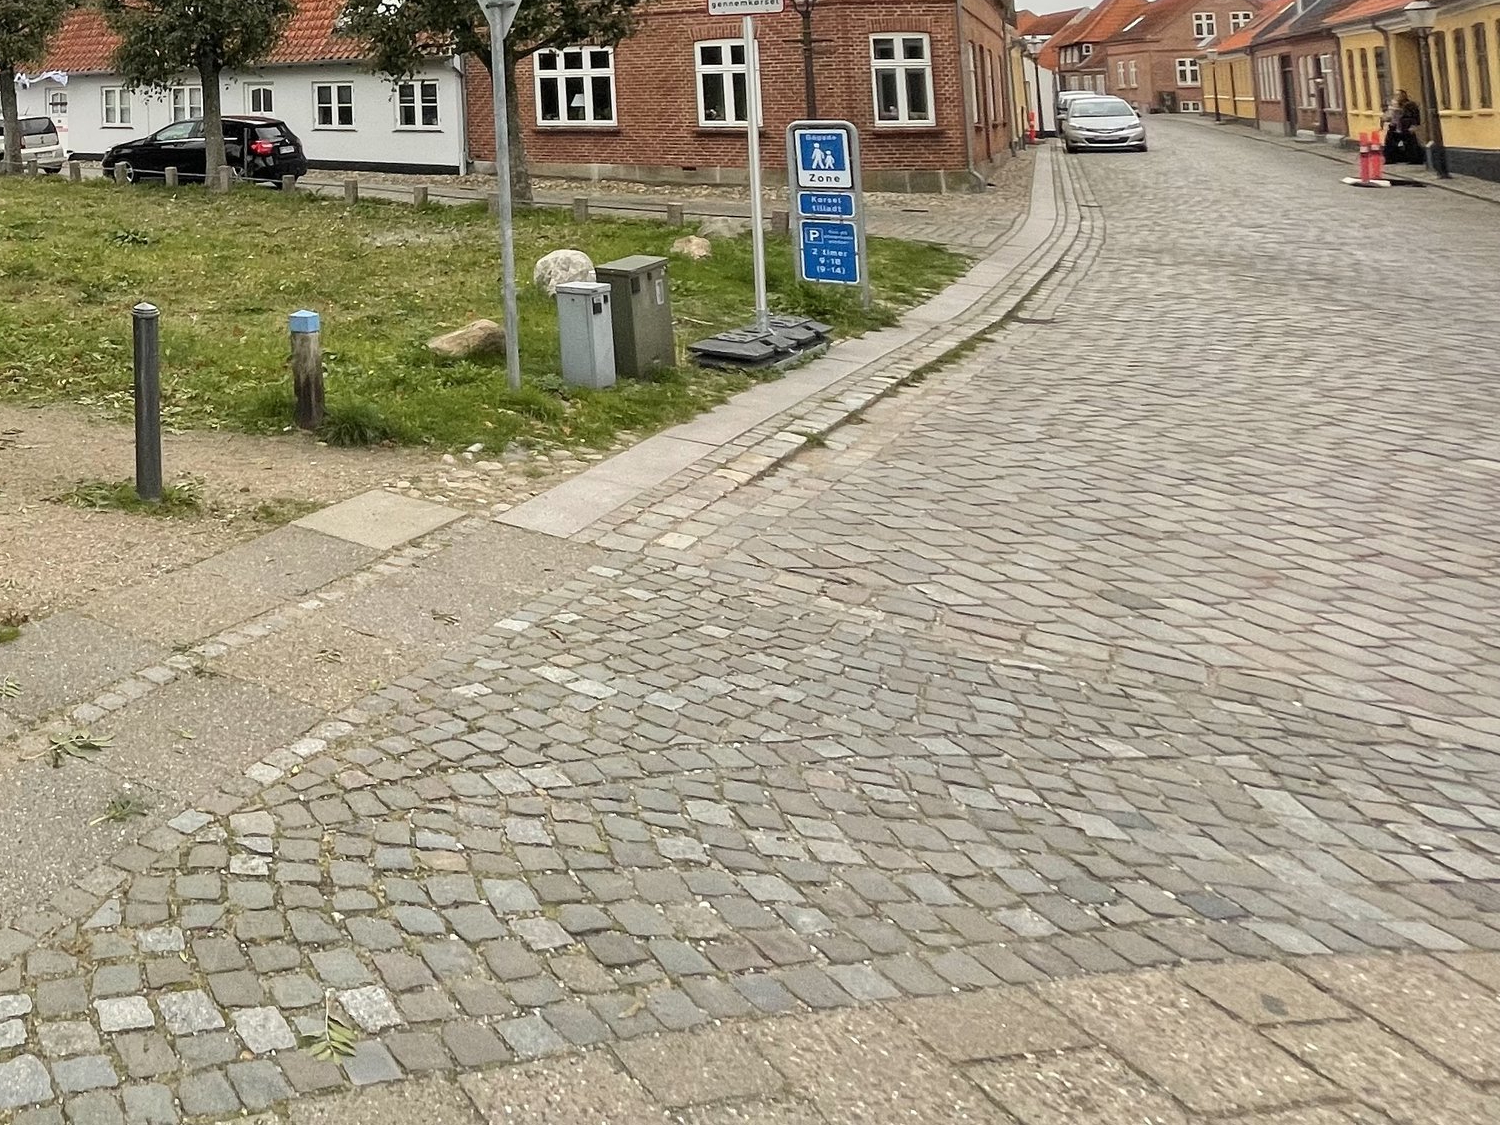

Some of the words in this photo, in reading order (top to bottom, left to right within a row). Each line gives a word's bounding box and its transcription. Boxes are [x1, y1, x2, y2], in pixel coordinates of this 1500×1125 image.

[809, 174, 841, 183] Zone
[812, 205, 842, 213] tilladt
[809, 229, 820, 242] P
[822, 249, 848, 257] timer
